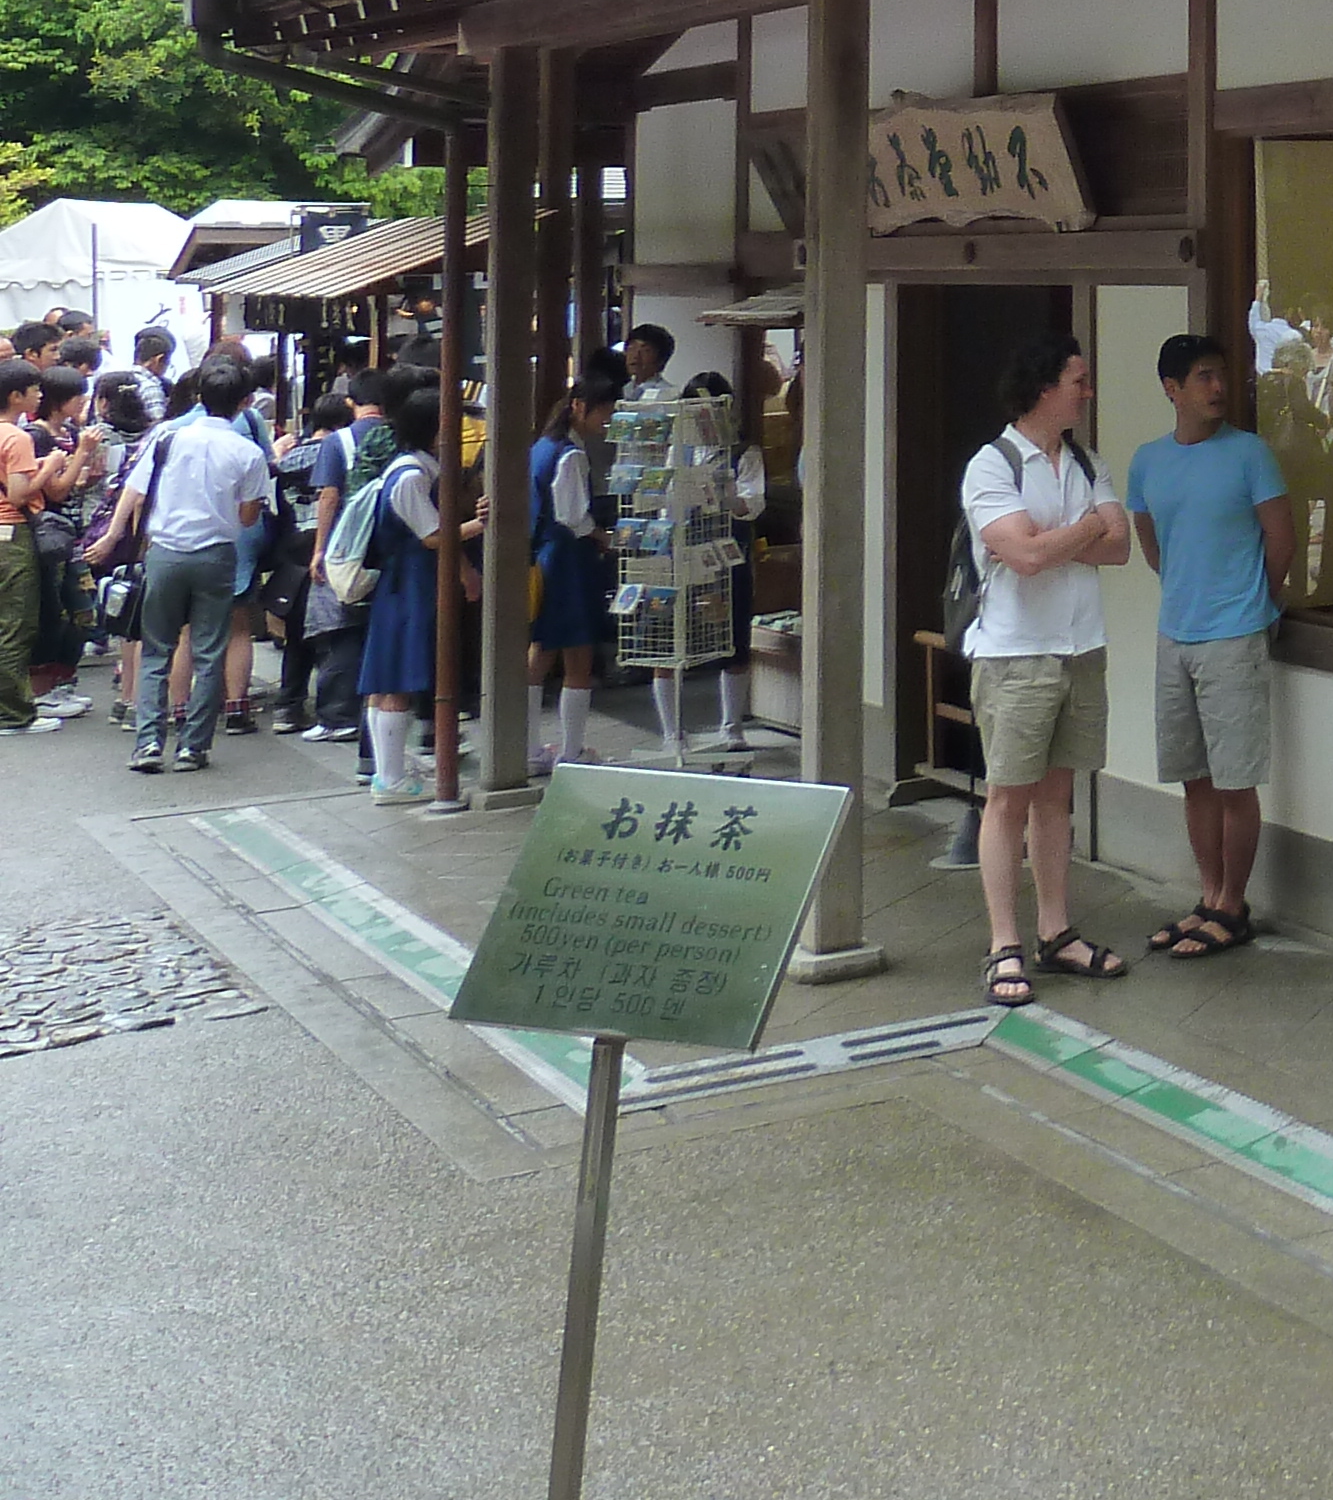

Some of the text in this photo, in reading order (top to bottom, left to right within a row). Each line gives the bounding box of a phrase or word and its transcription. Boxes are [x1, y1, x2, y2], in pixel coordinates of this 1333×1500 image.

[602, 797, 758, 851] お抹茶
[543, 876, 649, 905] Green tea
[508, 900, 773, 942] (includes small dessert)
[603, 932, 652, 957] (per
[654, 939, 741, 965] person)
[508, 952, 582, 980] 가루차
[600, 962, 658, 987] (과자
